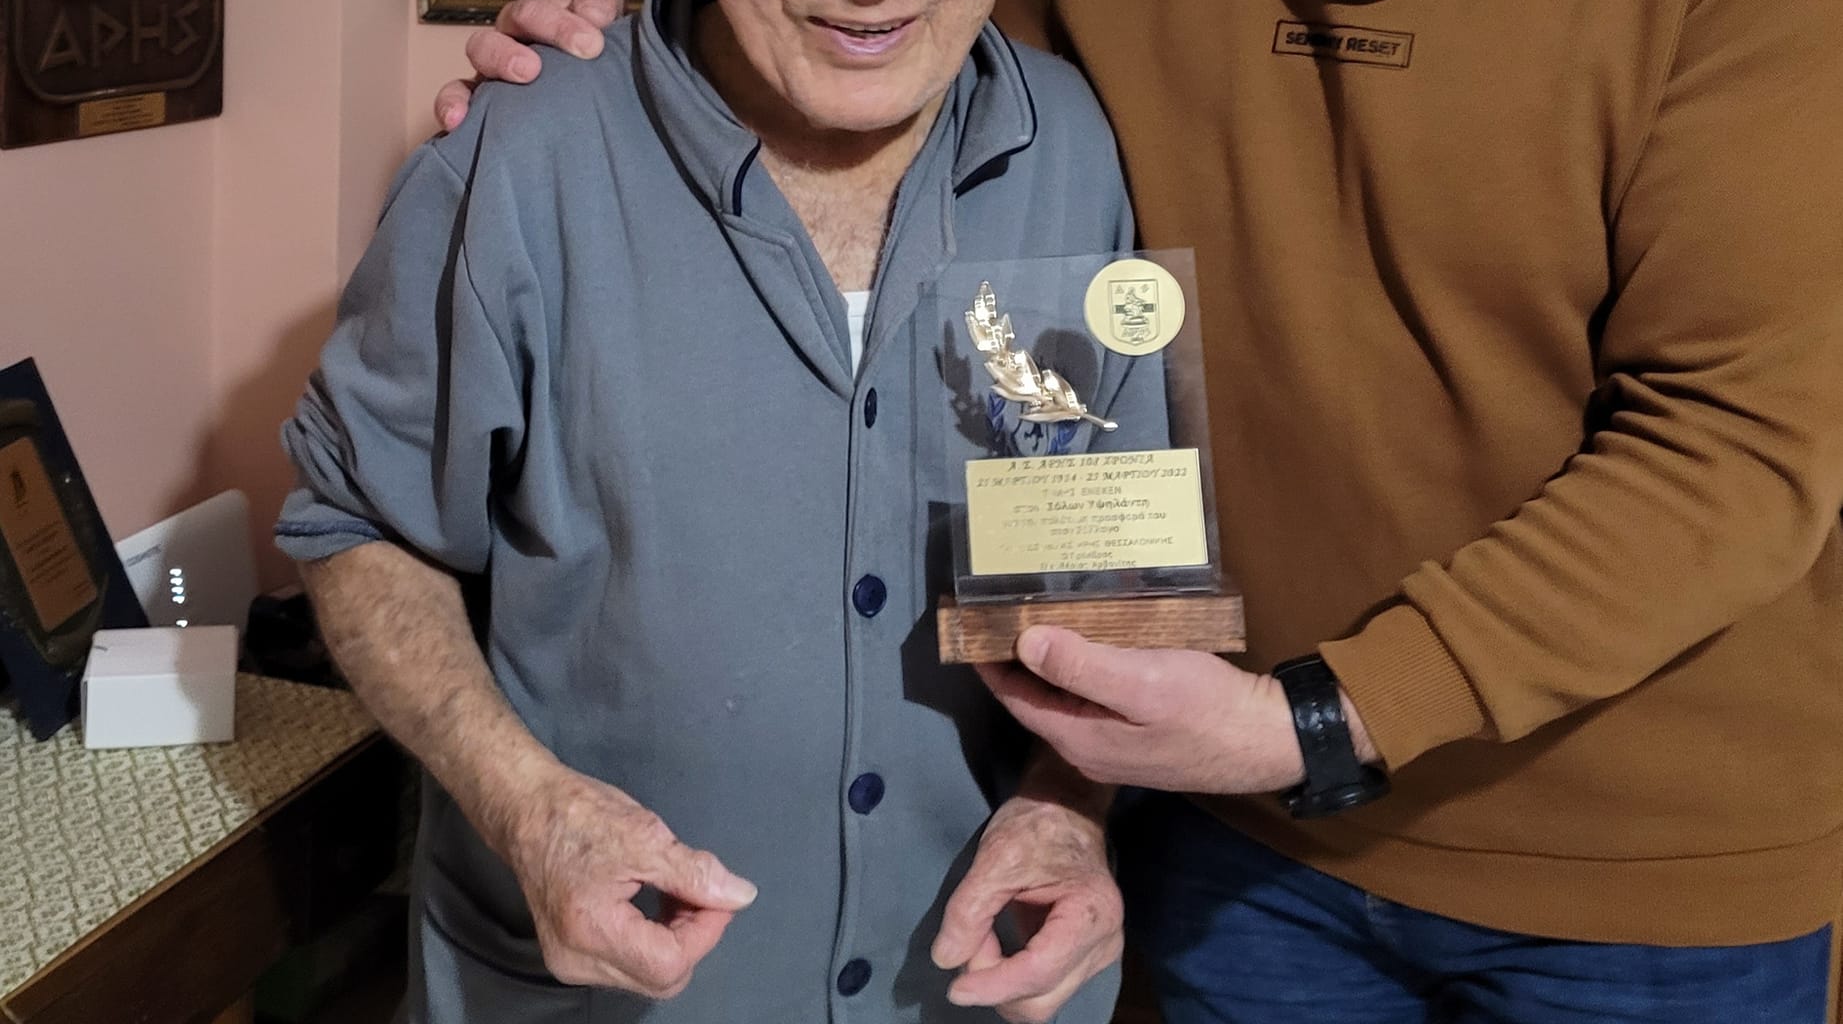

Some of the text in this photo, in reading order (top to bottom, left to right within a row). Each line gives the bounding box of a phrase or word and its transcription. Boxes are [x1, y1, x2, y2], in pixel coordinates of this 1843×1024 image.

[1346, 36, 1401, 56] RESET
[1038, 457, 1076, 471] ΑΡΗΣ
[1103, 454, 1154, 466] ΧΡΟΝΙΑ
[1103, 467, 1160, 480] ΜΑΡΤΙΟΥ
[1160, 467, 1188, 478] 2022
